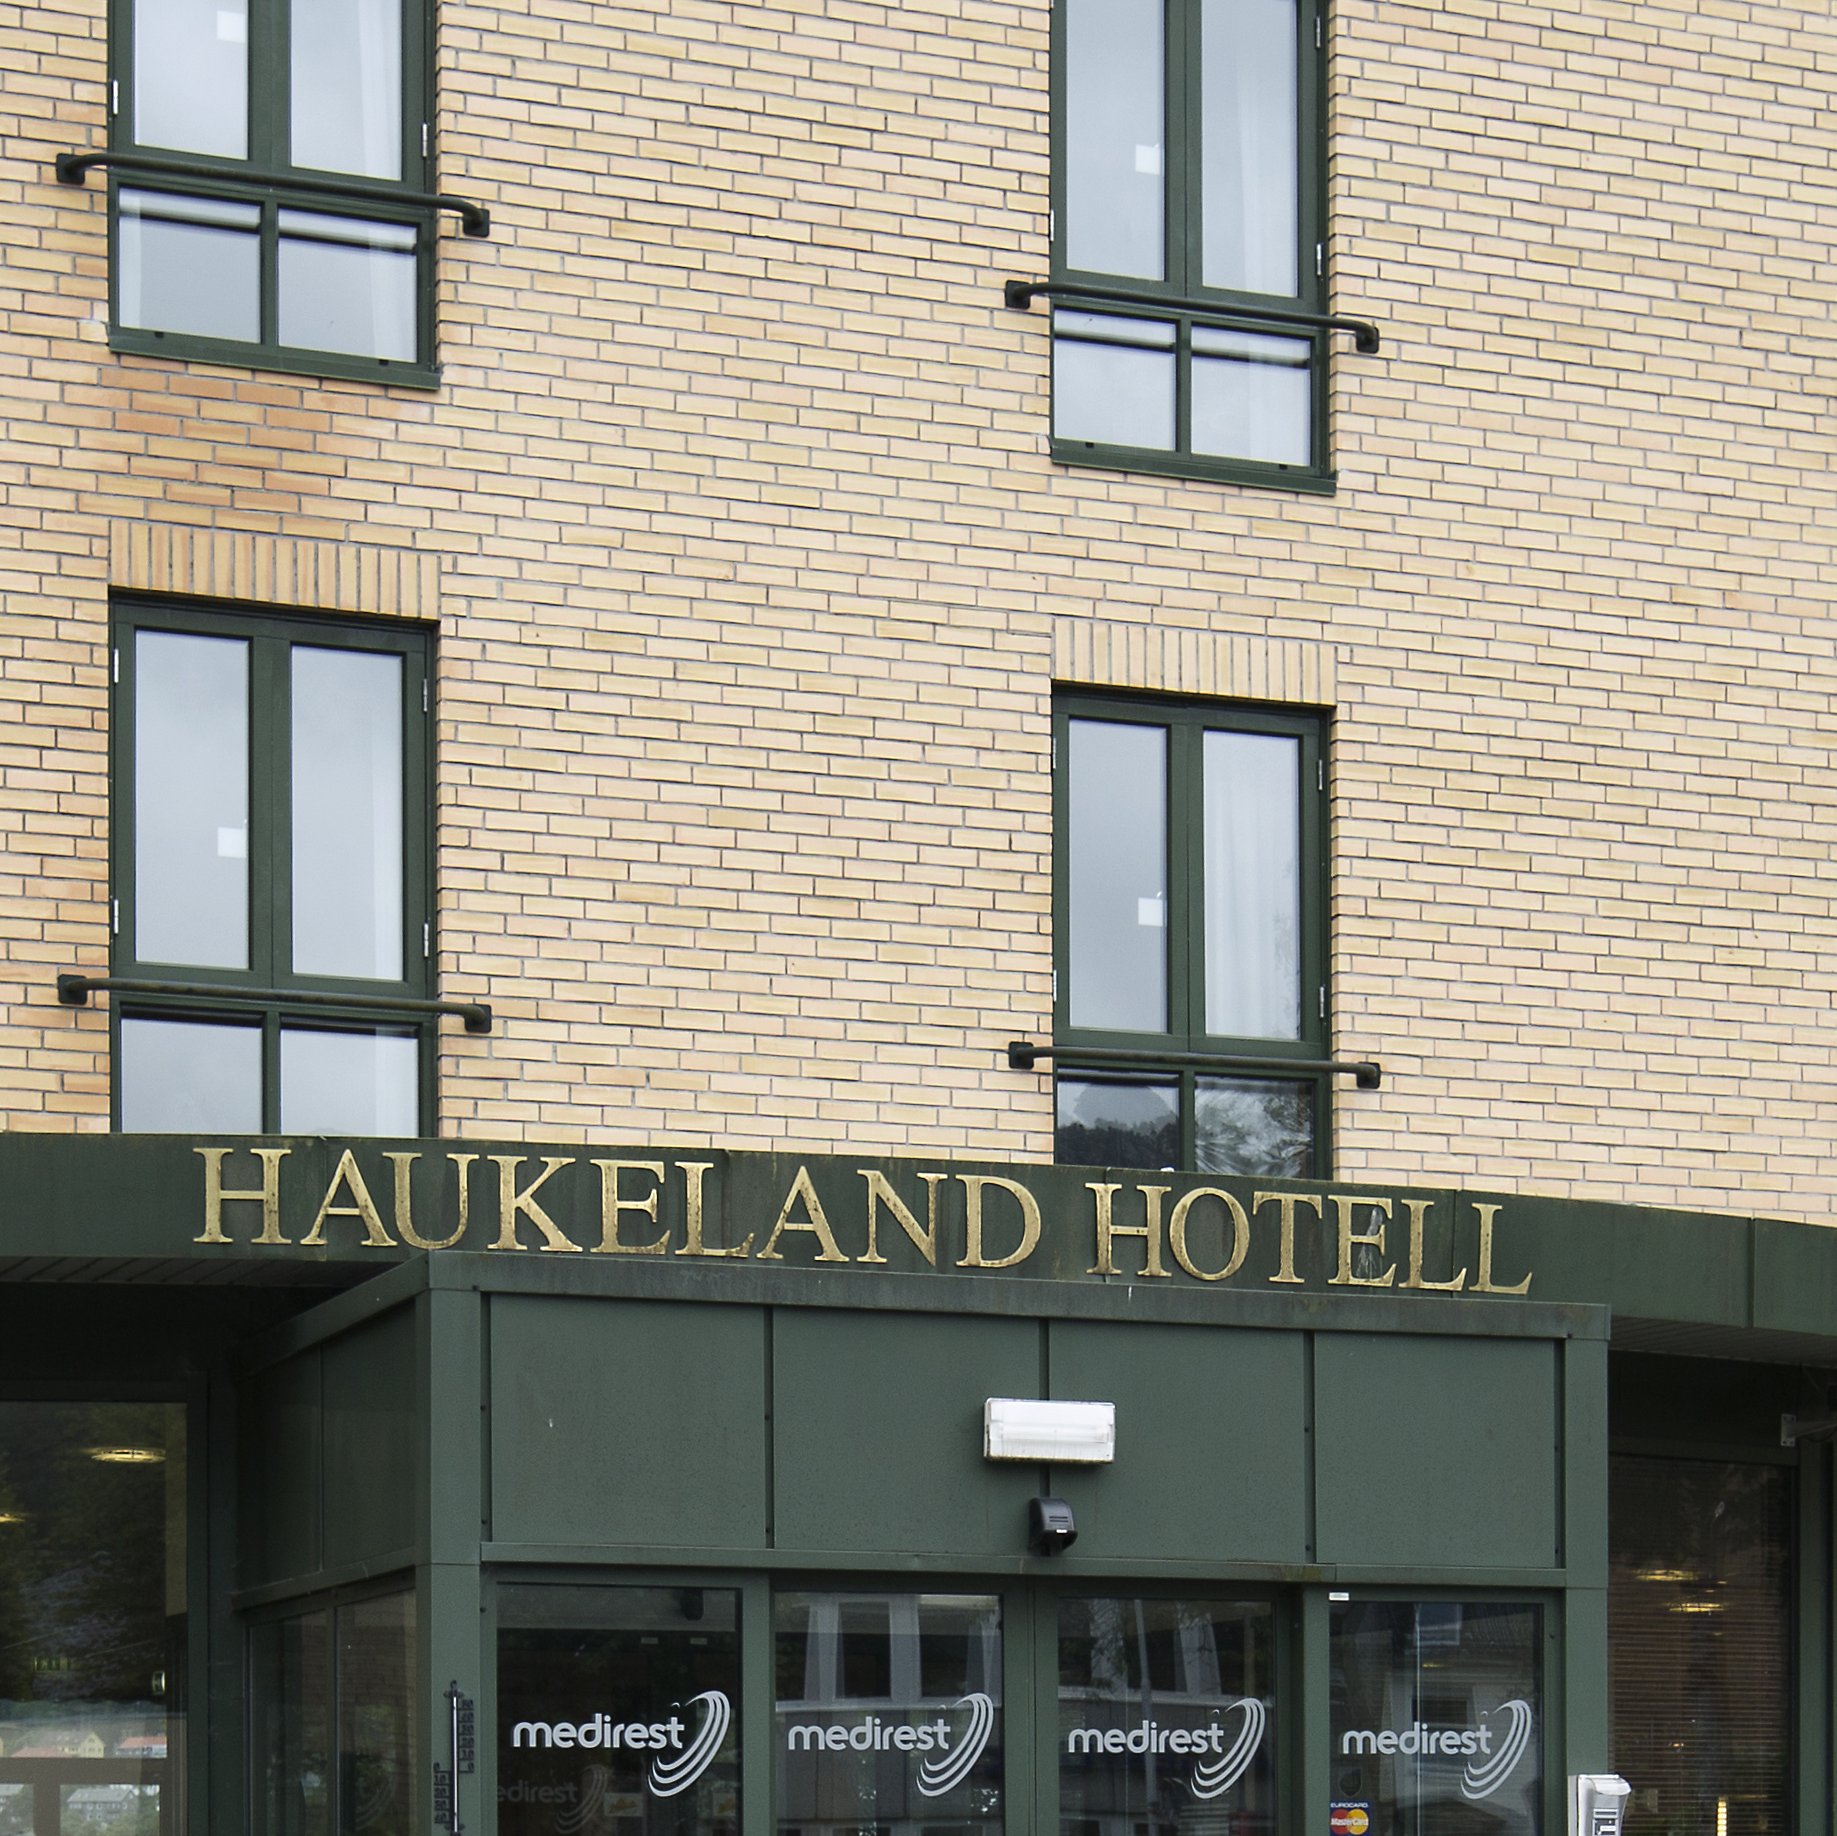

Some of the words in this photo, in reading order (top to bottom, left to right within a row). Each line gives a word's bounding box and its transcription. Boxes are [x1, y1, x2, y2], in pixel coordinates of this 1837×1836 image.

[192, 1147, 1041, 1268] HAUKELAND
[1084, 1181, 1532, 1295] HOTELL
[513, 1713, 685, 1749] medirest
[787, 1716, 951, 1752] medirest
[1068, 1720, 1224, 1754] medirest
[1342, 1722, 1492, 1755] medirest
[433, 1762, 440, 1771] 0
[461, 1749, 474, 1758] 10
[467, 1762, 474, 1771] 0
[434, 1774, 447, 1783] 10
[497, 1780, 577, 1803] edirest
